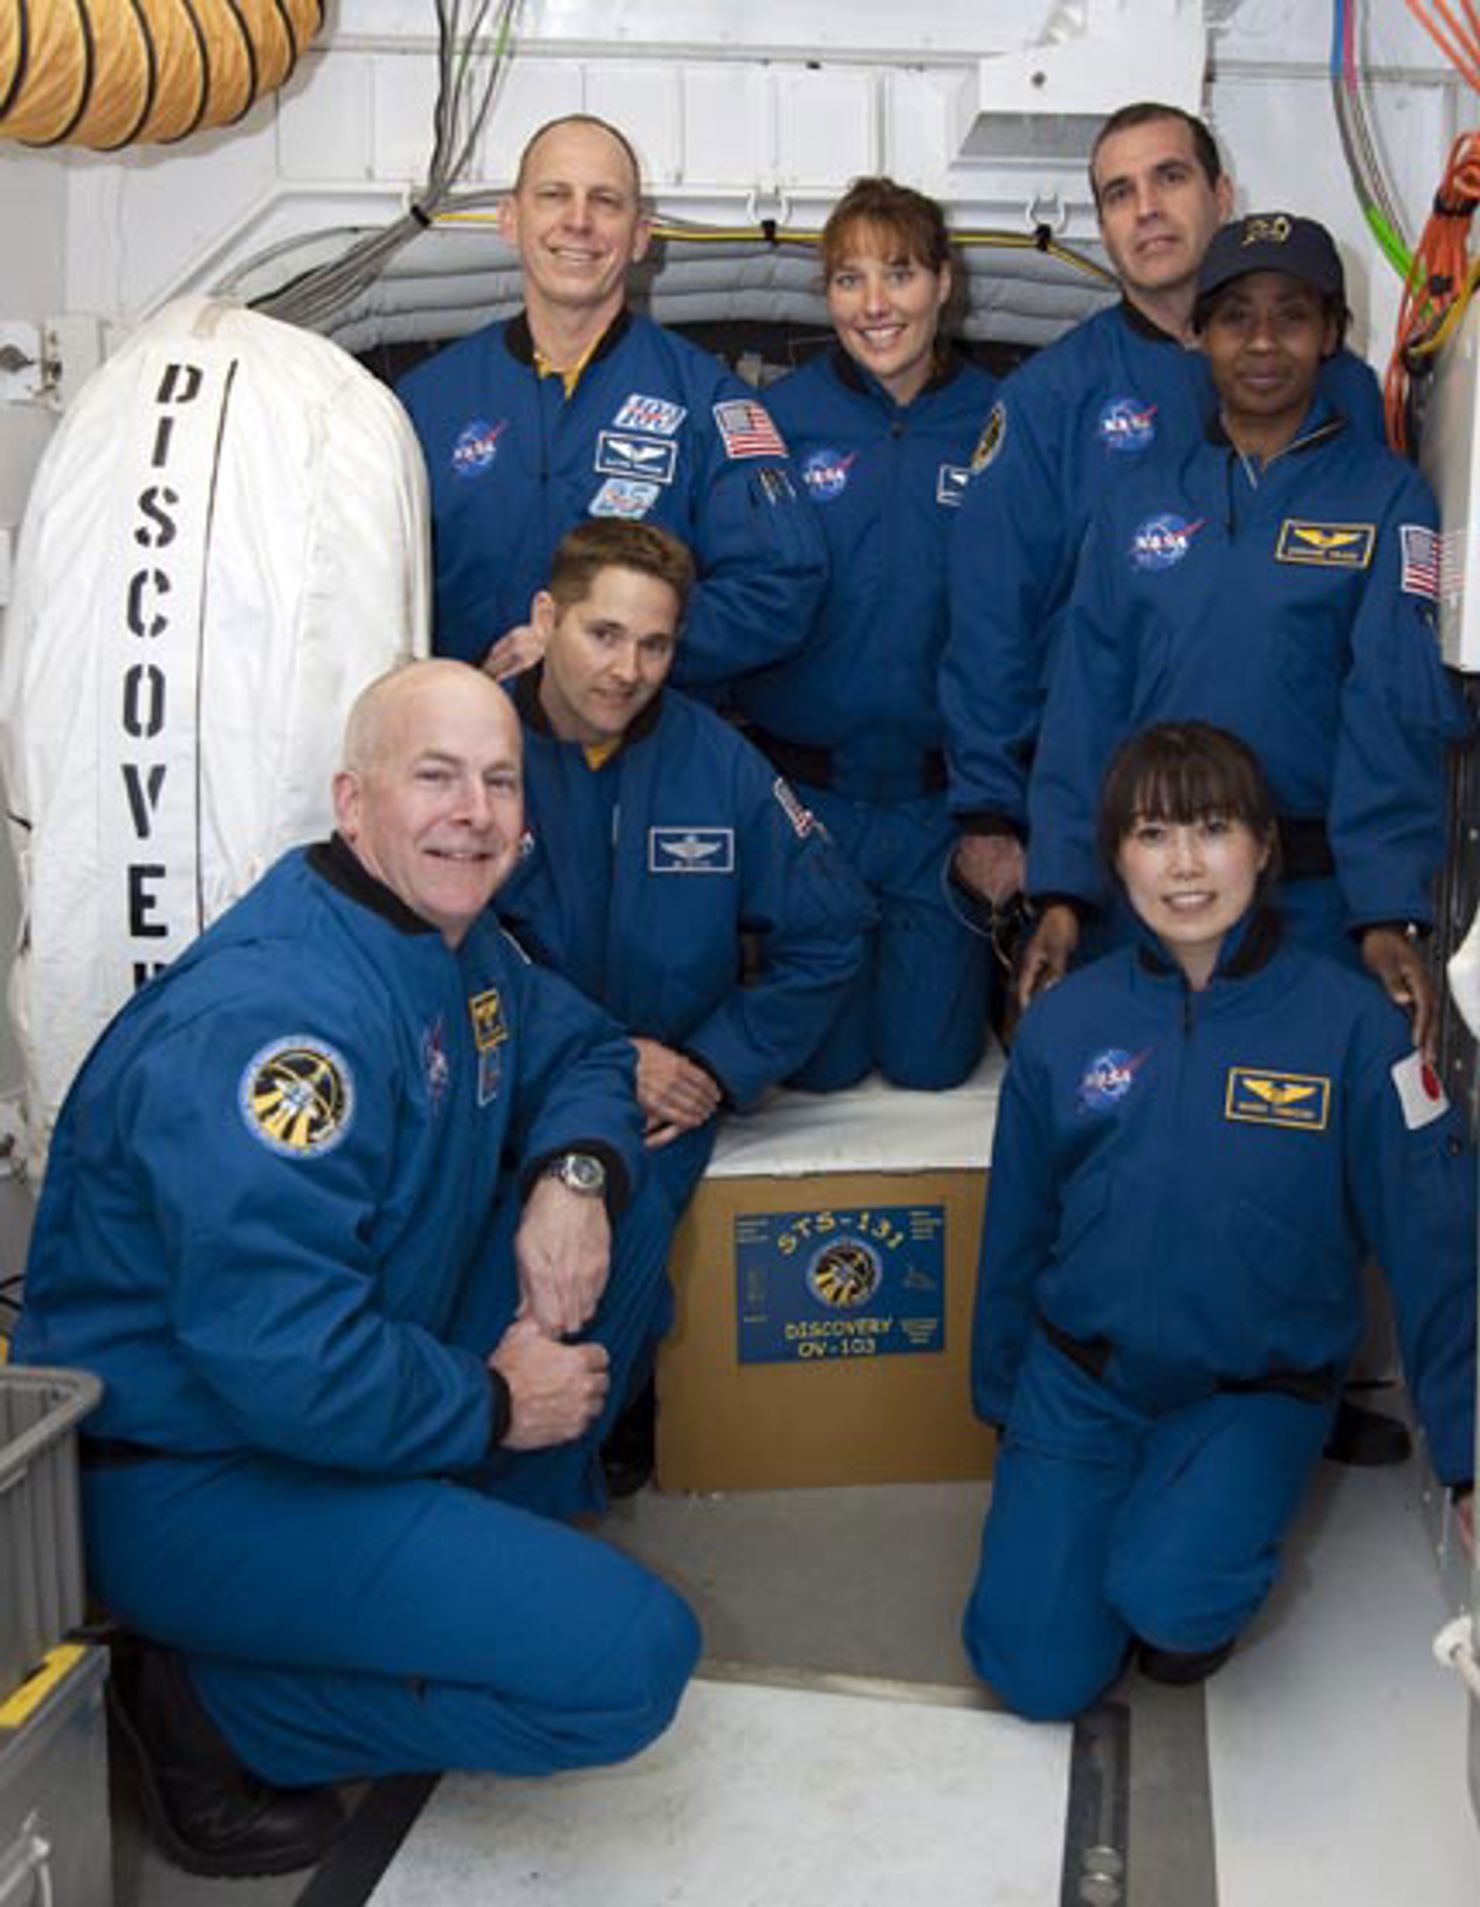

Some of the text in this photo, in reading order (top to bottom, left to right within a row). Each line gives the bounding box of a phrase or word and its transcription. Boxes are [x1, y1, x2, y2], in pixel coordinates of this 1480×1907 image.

[1136, 534, 1188, 549] NASA
[121, 362, 203, 990] DISCOVE
[778, 1211, 904, 1254] STS-131
[784, 1317, 892, 1339] DISCOVERY
[798, 1338, 877, 1357] OV-103
